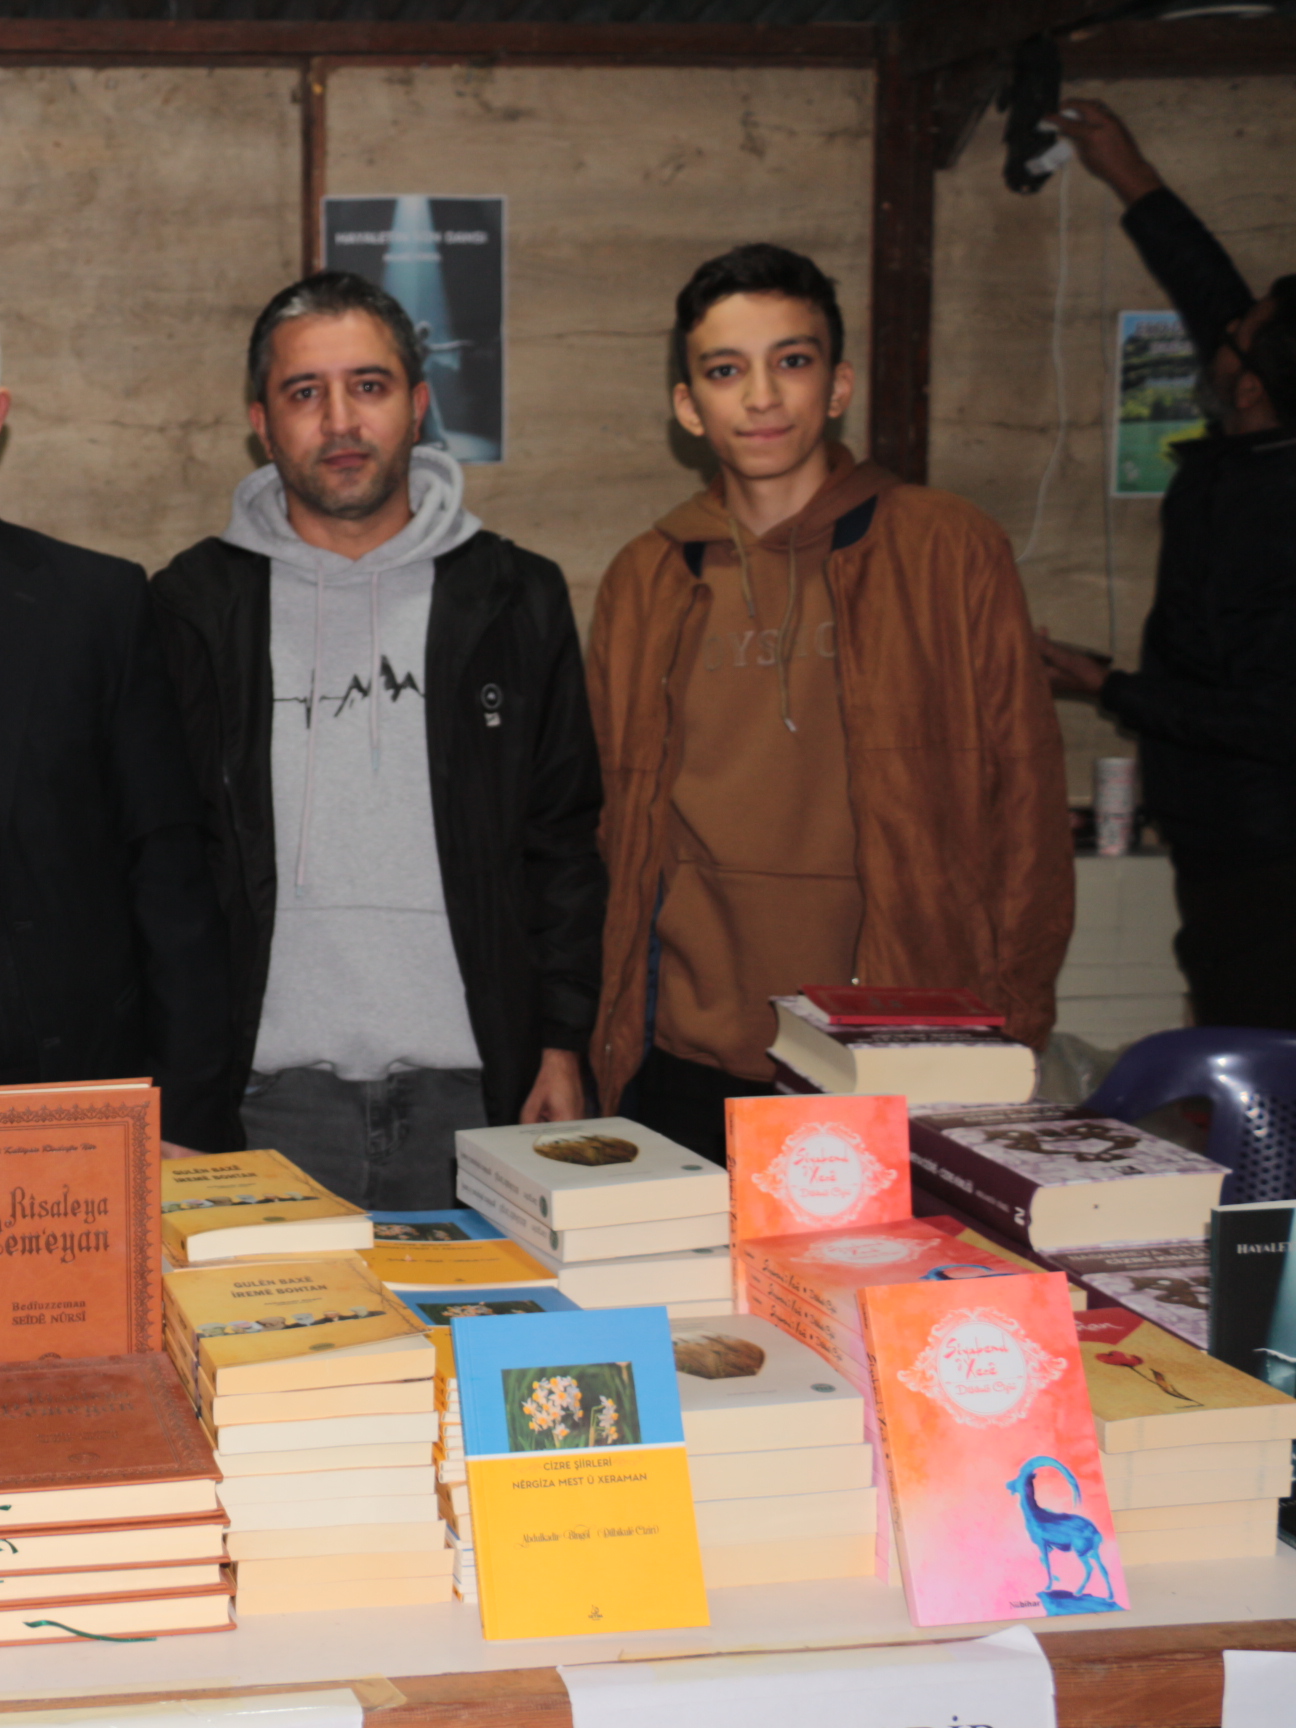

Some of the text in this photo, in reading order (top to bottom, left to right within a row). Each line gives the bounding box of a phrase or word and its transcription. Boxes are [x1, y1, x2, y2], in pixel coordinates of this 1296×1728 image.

[275, 1285, 328, 1294] BOHTAN
[543, 1460, 572, 1471] CİZRE
[558, 1477, 584, 1487] MEST
[598, 1473, 648, 1485] XERAMAN
